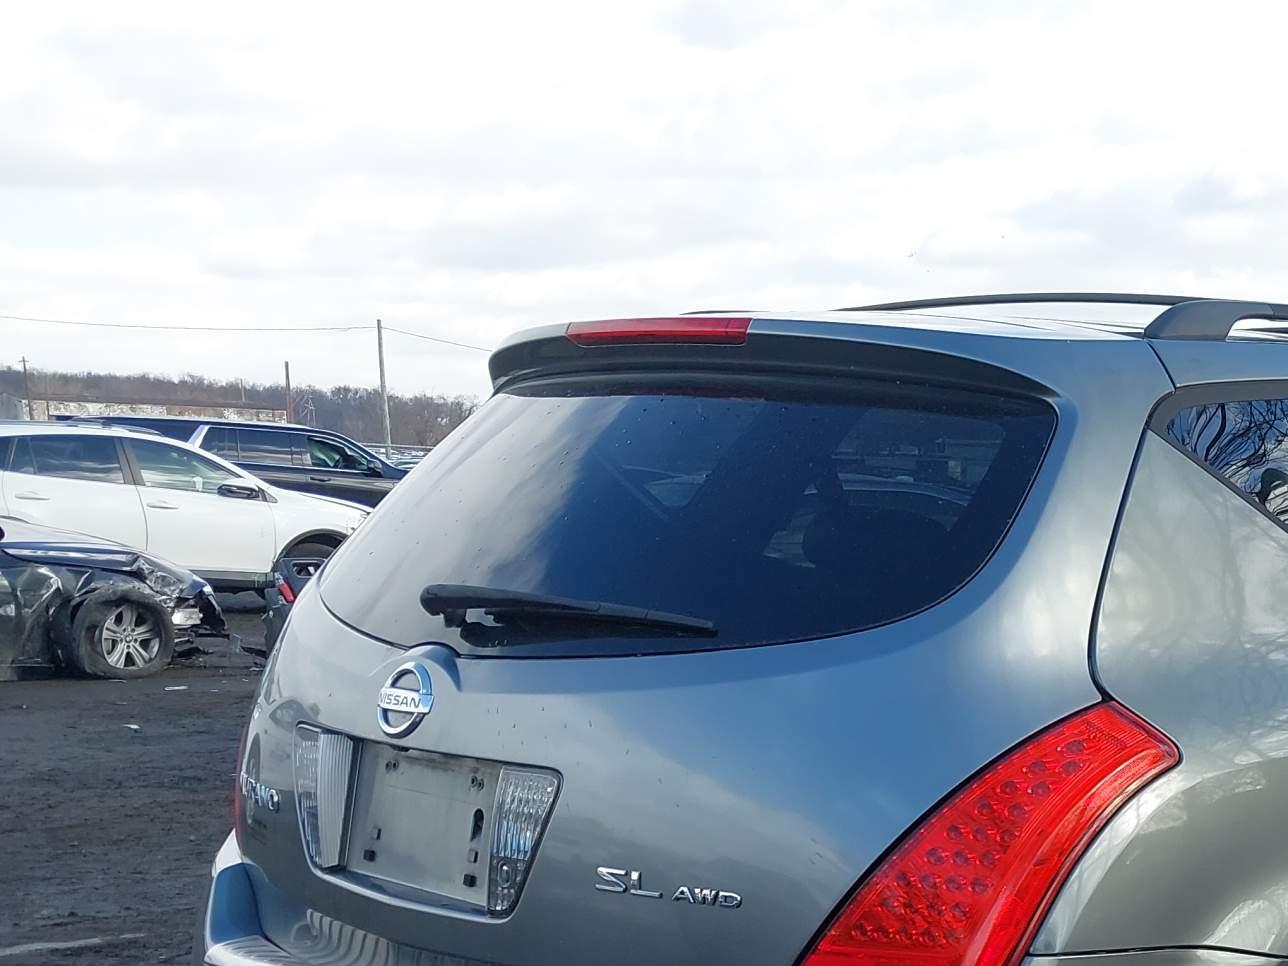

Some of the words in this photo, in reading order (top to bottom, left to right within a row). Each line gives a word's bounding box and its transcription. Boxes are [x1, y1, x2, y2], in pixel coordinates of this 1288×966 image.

[380, 692, 421, 709] NISSAN
[595, 866, 662, 899] SL
[672, 885, 742, 908] AWD
